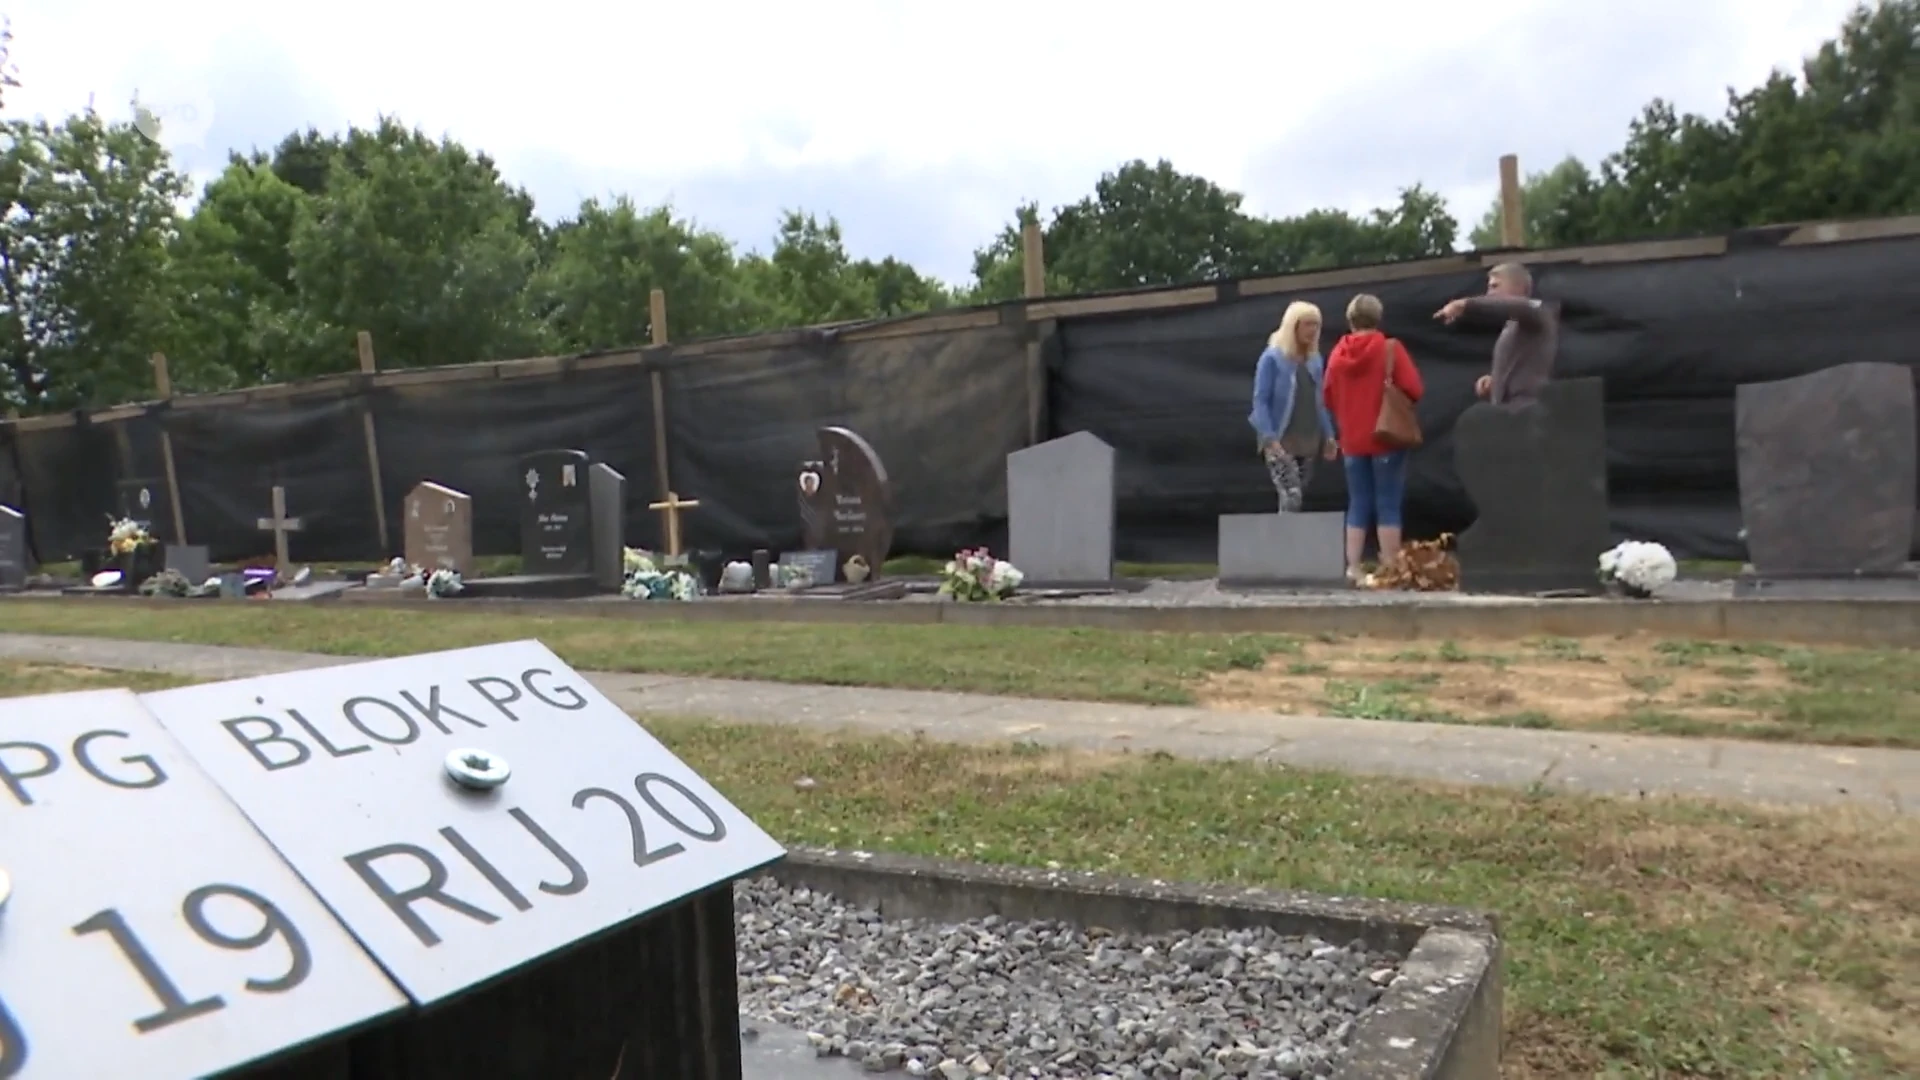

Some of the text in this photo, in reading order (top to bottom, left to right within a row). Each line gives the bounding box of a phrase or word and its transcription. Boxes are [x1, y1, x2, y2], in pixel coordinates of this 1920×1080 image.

[0, 730, 167, 805] PG
[220, 667, 588, 771] BLOK PG
[343, 772, 727, 948] RIJ 20
[72, 882, 312, 1033] 19
